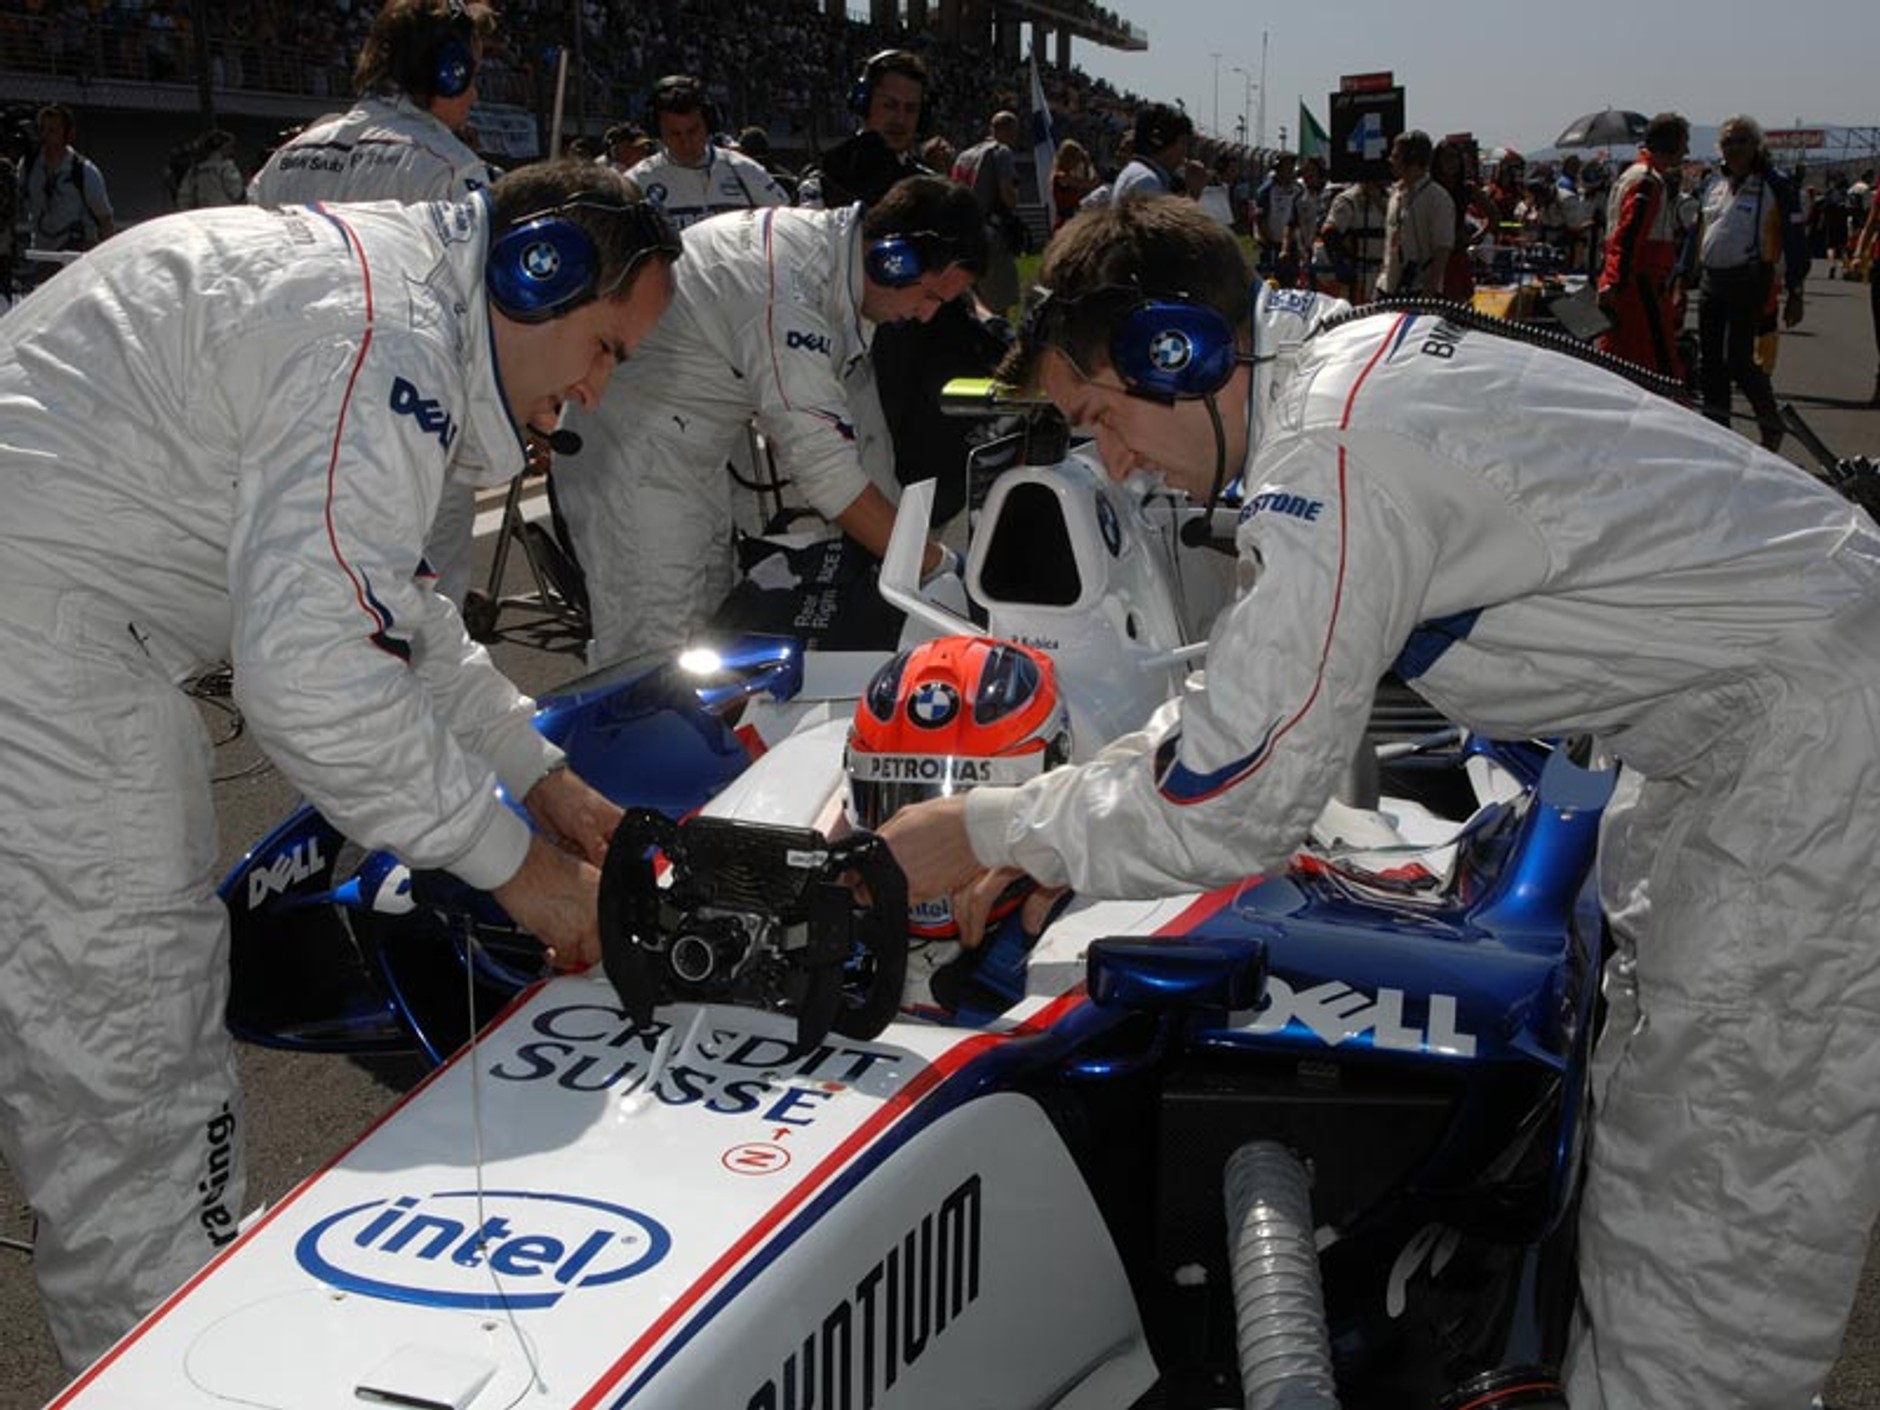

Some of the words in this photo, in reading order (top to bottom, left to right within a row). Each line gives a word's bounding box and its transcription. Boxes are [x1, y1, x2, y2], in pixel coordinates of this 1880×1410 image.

[1347, 112, 1388, 160] 4
[869, 756, 992, 782] PETRONAS
[249, 836, 326, 912] DELL
[1228, 975, 1477, 1058] DELL
[354, 1196, 616, 1286] intel
[746, 1172, 982, 1410] NTIUM
